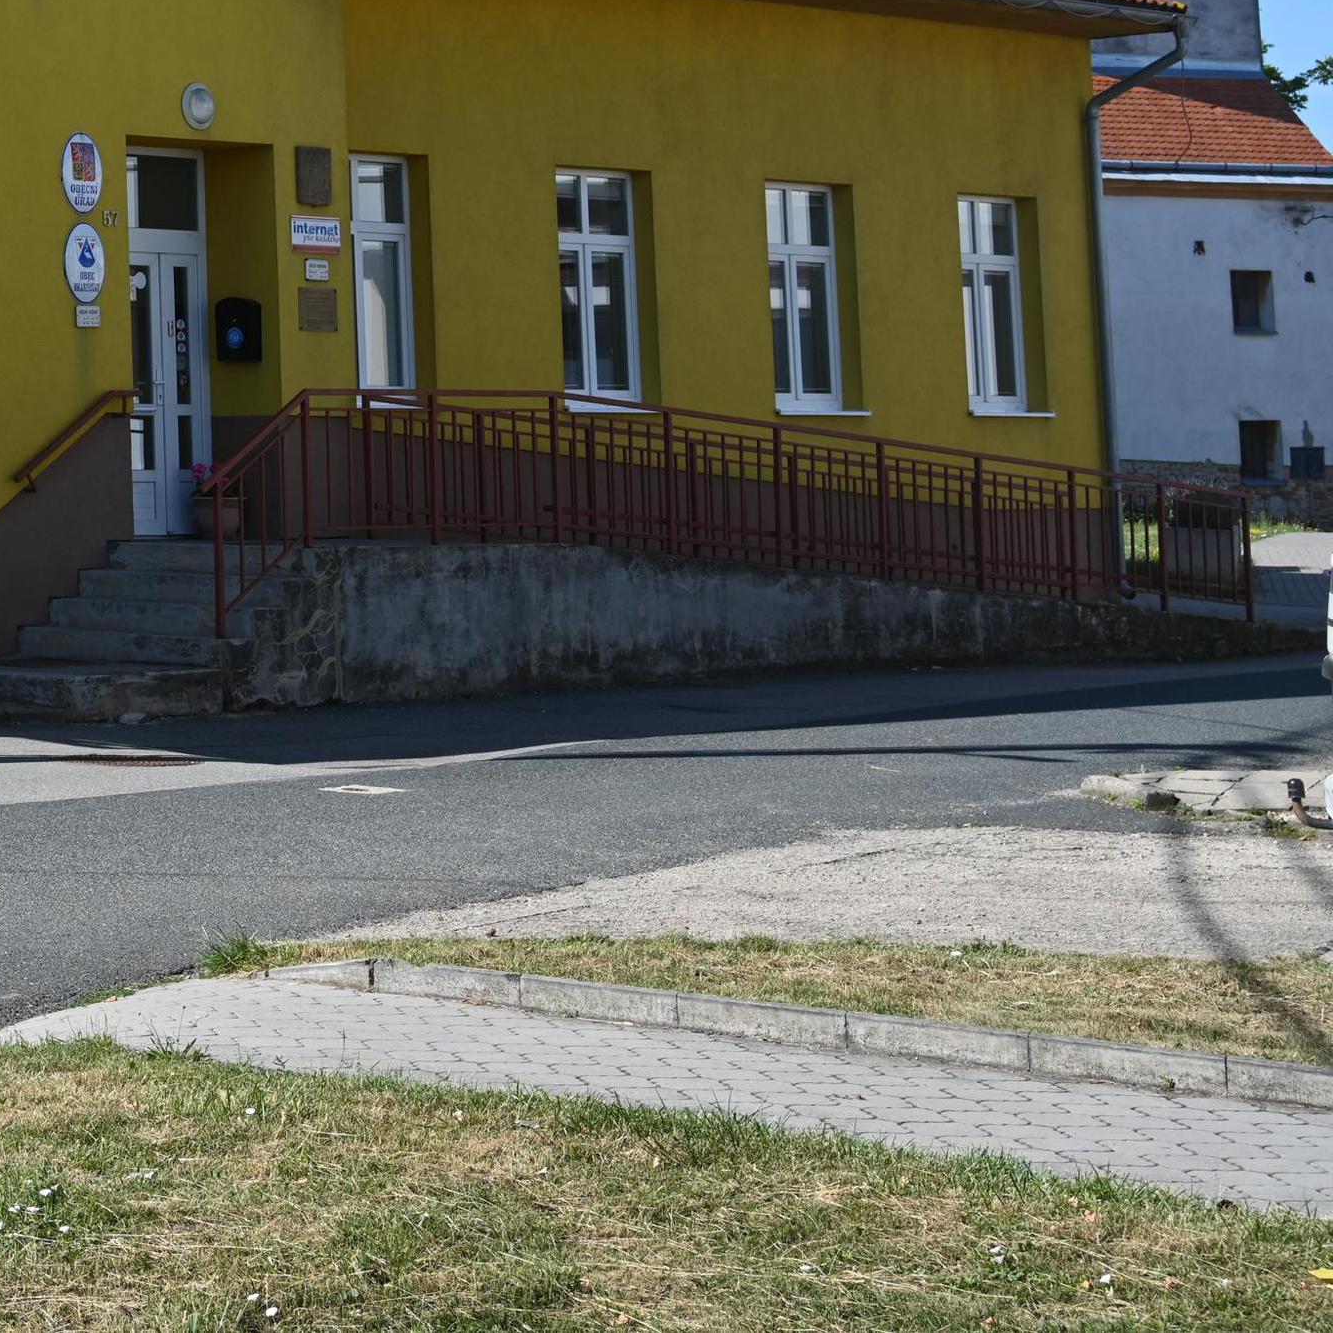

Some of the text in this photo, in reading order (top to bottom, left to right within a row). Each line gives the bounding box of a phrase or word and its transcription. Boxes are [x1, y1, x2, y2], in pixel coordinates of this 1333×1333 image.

[103, 210, 119, 227] 57
[293, 221, 338, 235] internet
[79, 271, 96, 281] OBEC
